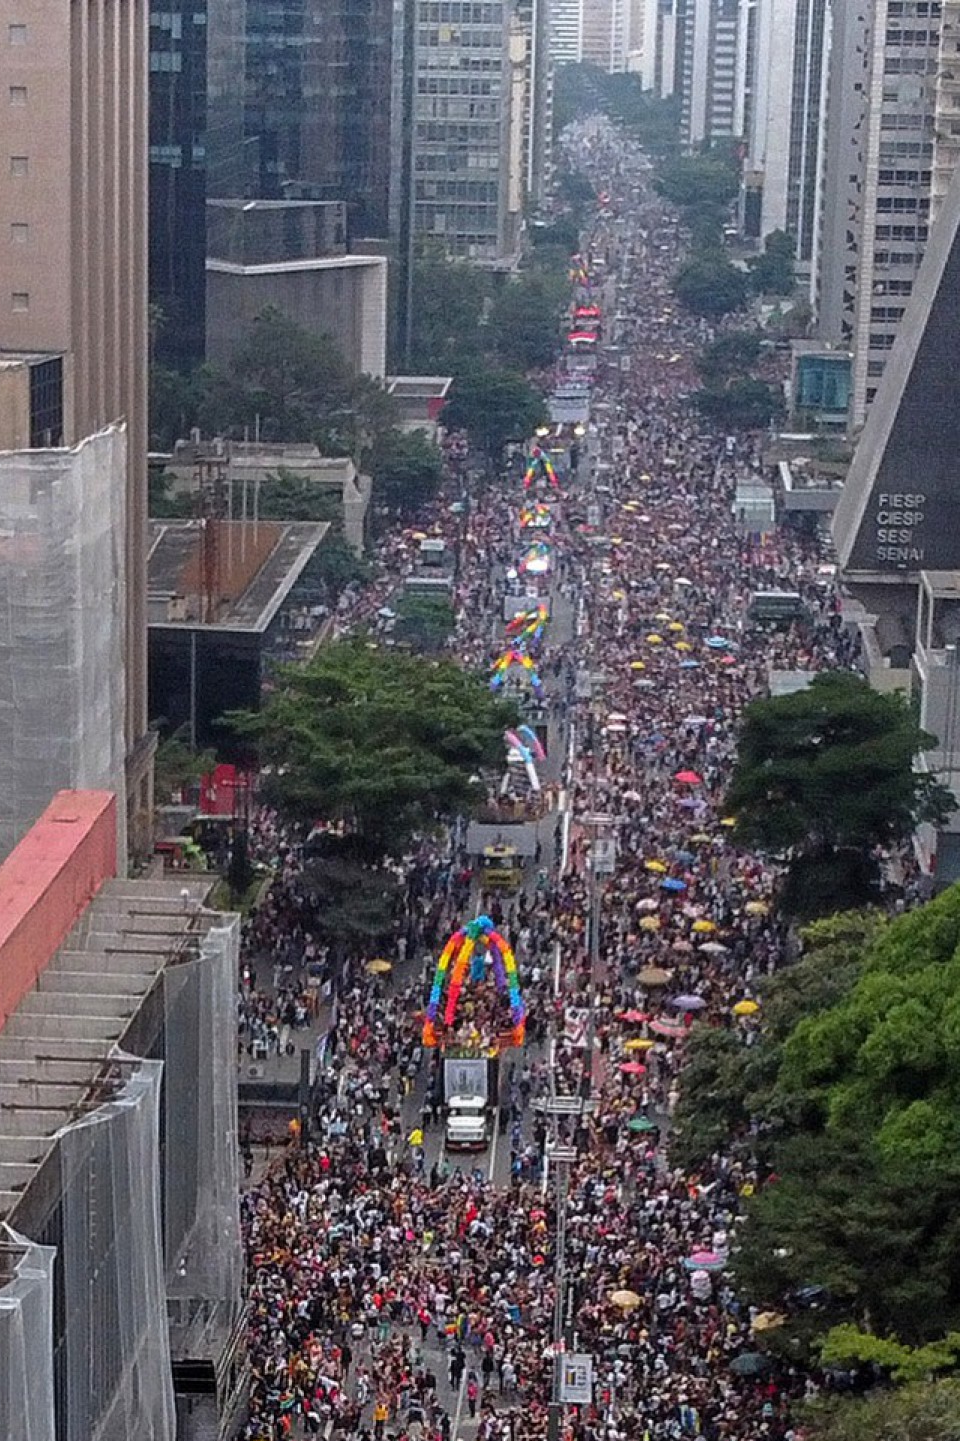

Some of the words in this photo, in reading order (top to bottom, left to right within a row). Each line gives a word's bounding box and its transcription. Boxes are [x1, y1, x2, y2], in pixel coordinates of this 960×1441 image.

[879, 494, 926, 507] FIESP
[877, 511, 924, 525] CIESP
[877, 529, 913, 543] SESI
[877, 547, 924, 560] SENAI
